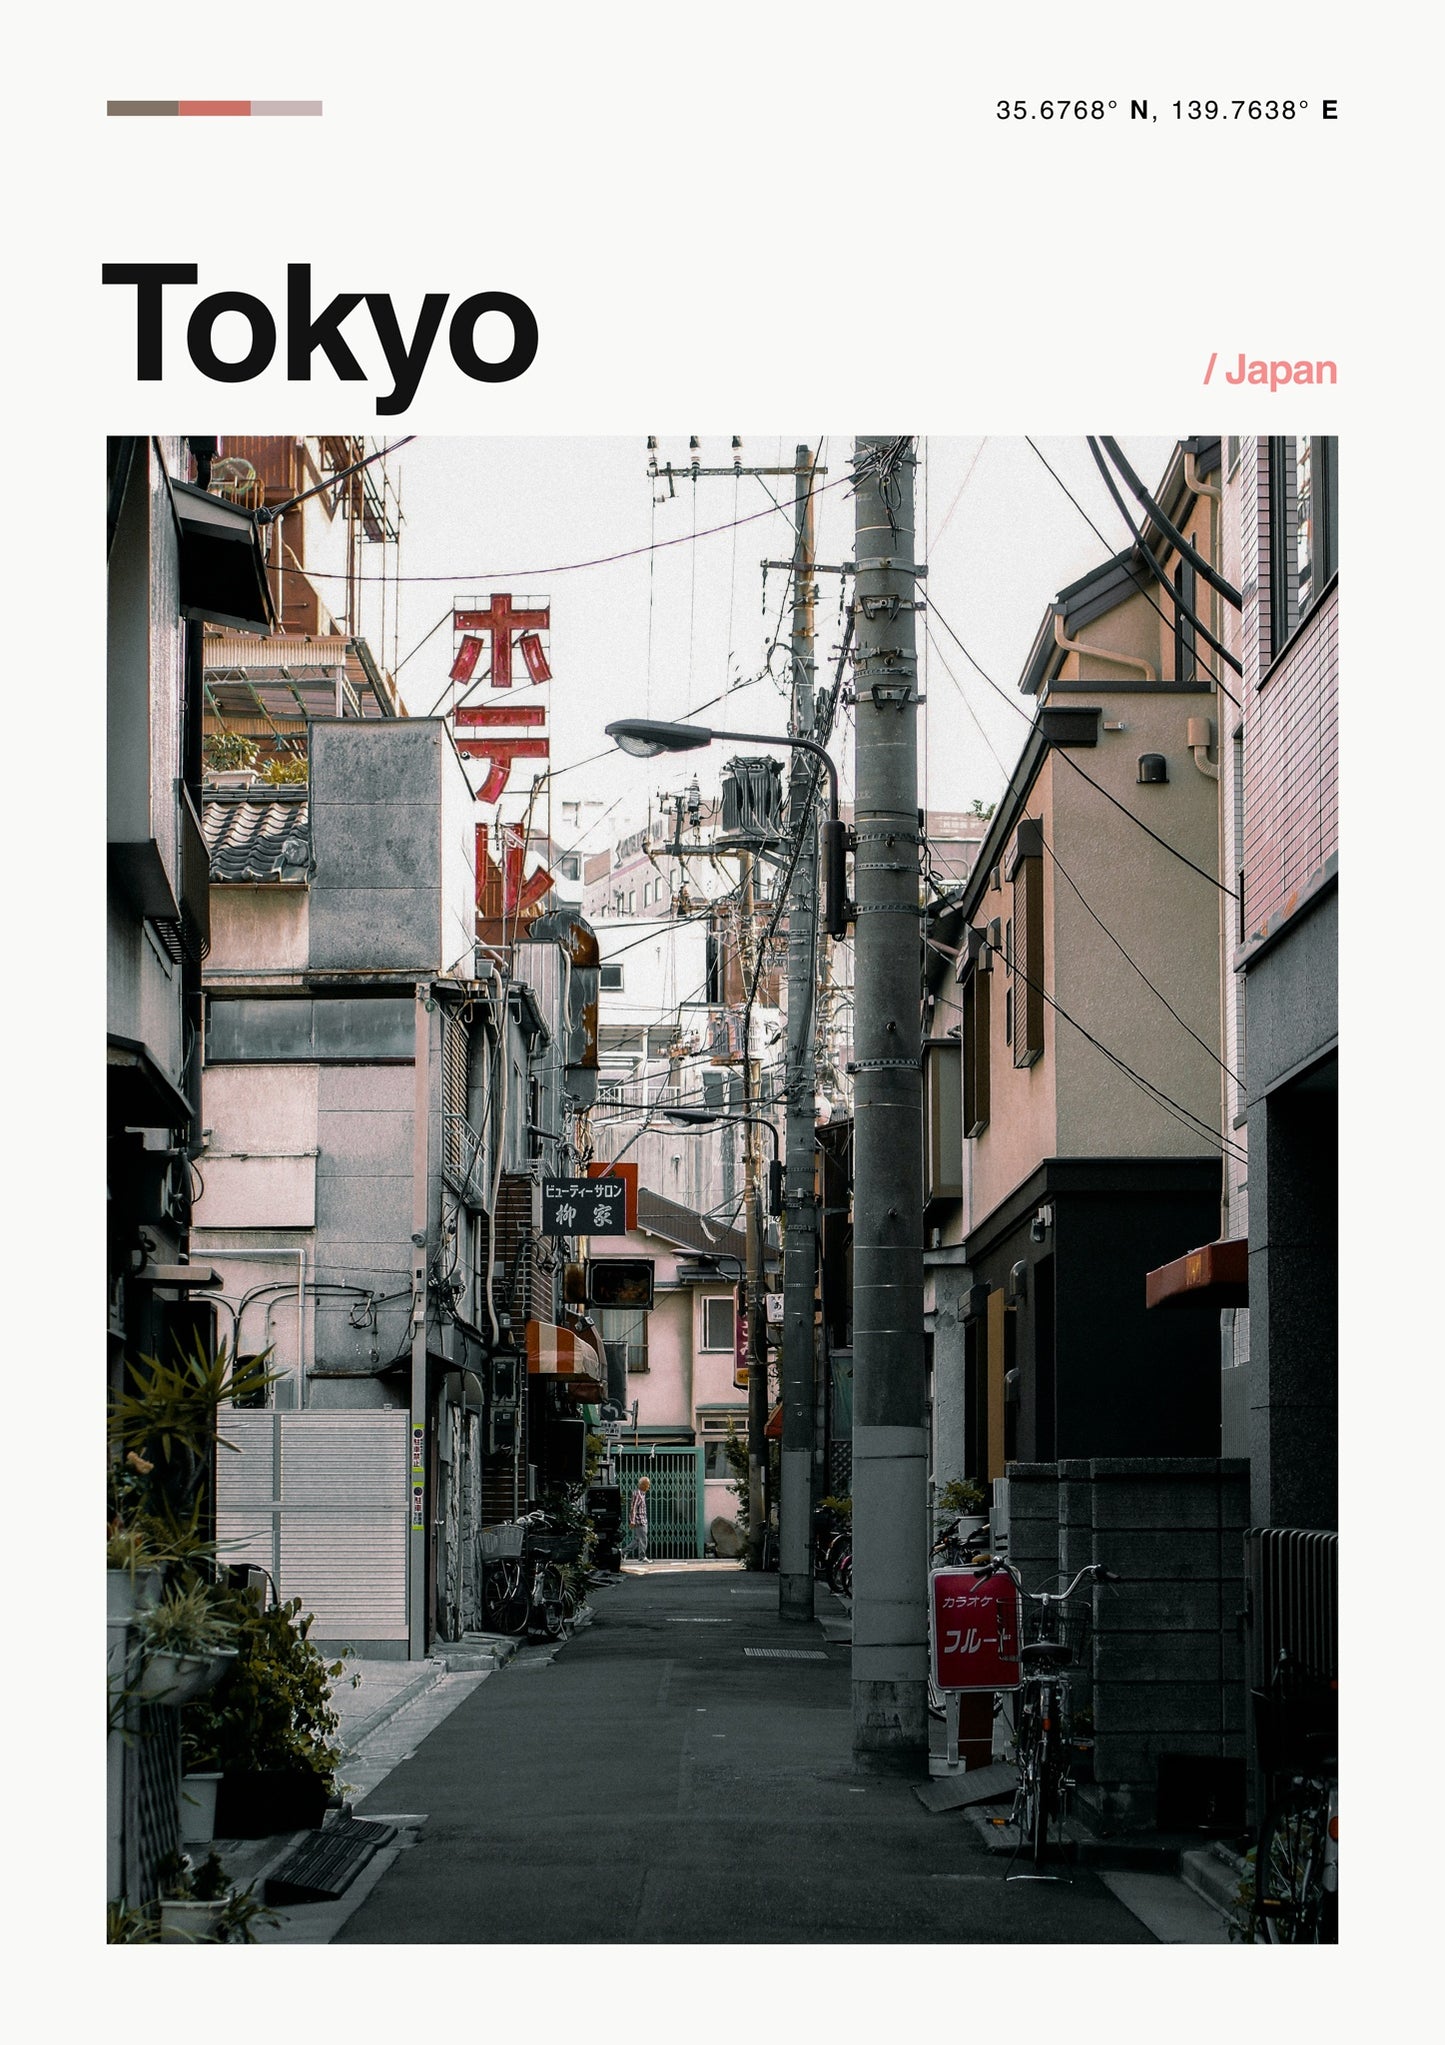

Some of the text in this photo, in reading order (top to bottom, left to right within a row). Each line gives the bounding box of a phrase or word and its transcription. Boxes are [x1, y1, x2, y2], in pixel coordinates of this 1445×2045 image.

[449, 593, 554, 918] ホテル
[546, 1184, 622, 1198] ビューティーサロン
[942, 1596, 993, 1608] カラオケ
